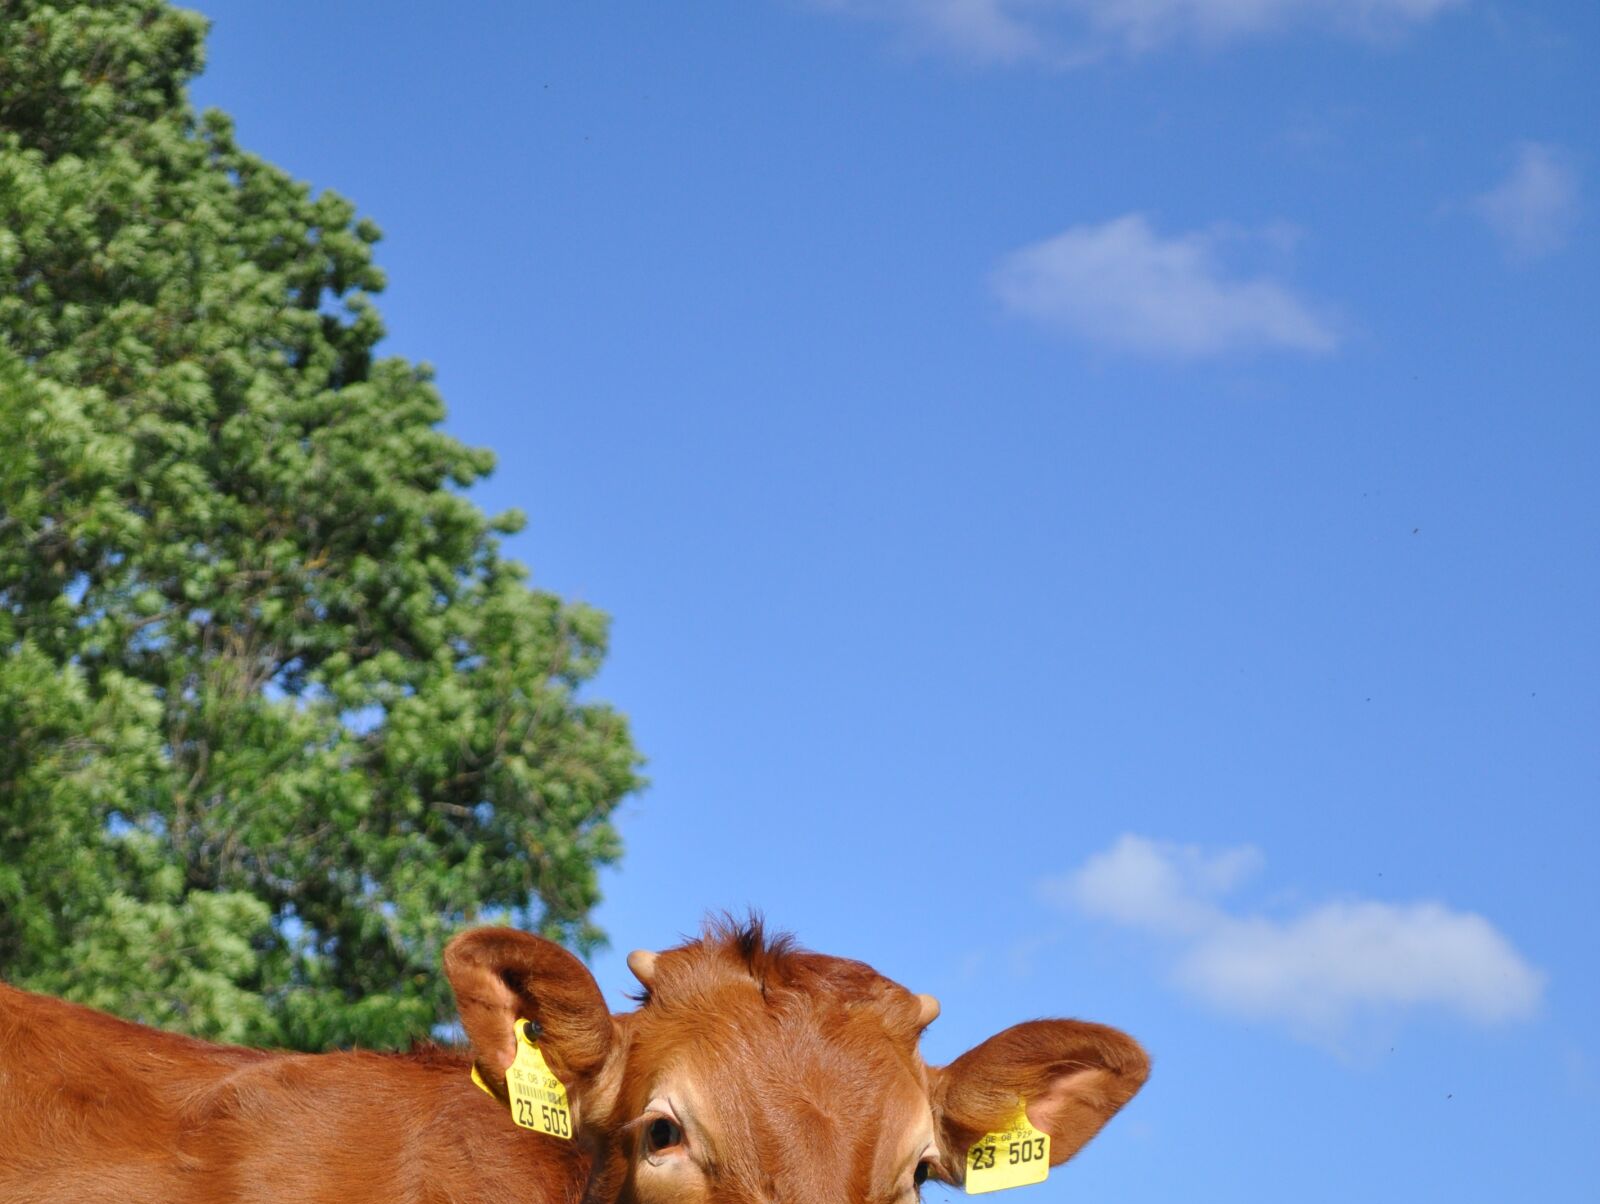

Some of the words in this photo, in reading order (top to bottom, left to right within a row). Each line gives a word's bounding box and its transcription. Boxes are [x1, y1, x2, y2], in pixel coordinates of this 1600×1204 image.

[516, 1098, 534, 1127] 23
[542, 1105, 569, 1137] 503
[972, 1145, 997, 1171] 23
[1009, 1137, 1046, 1165] 503
